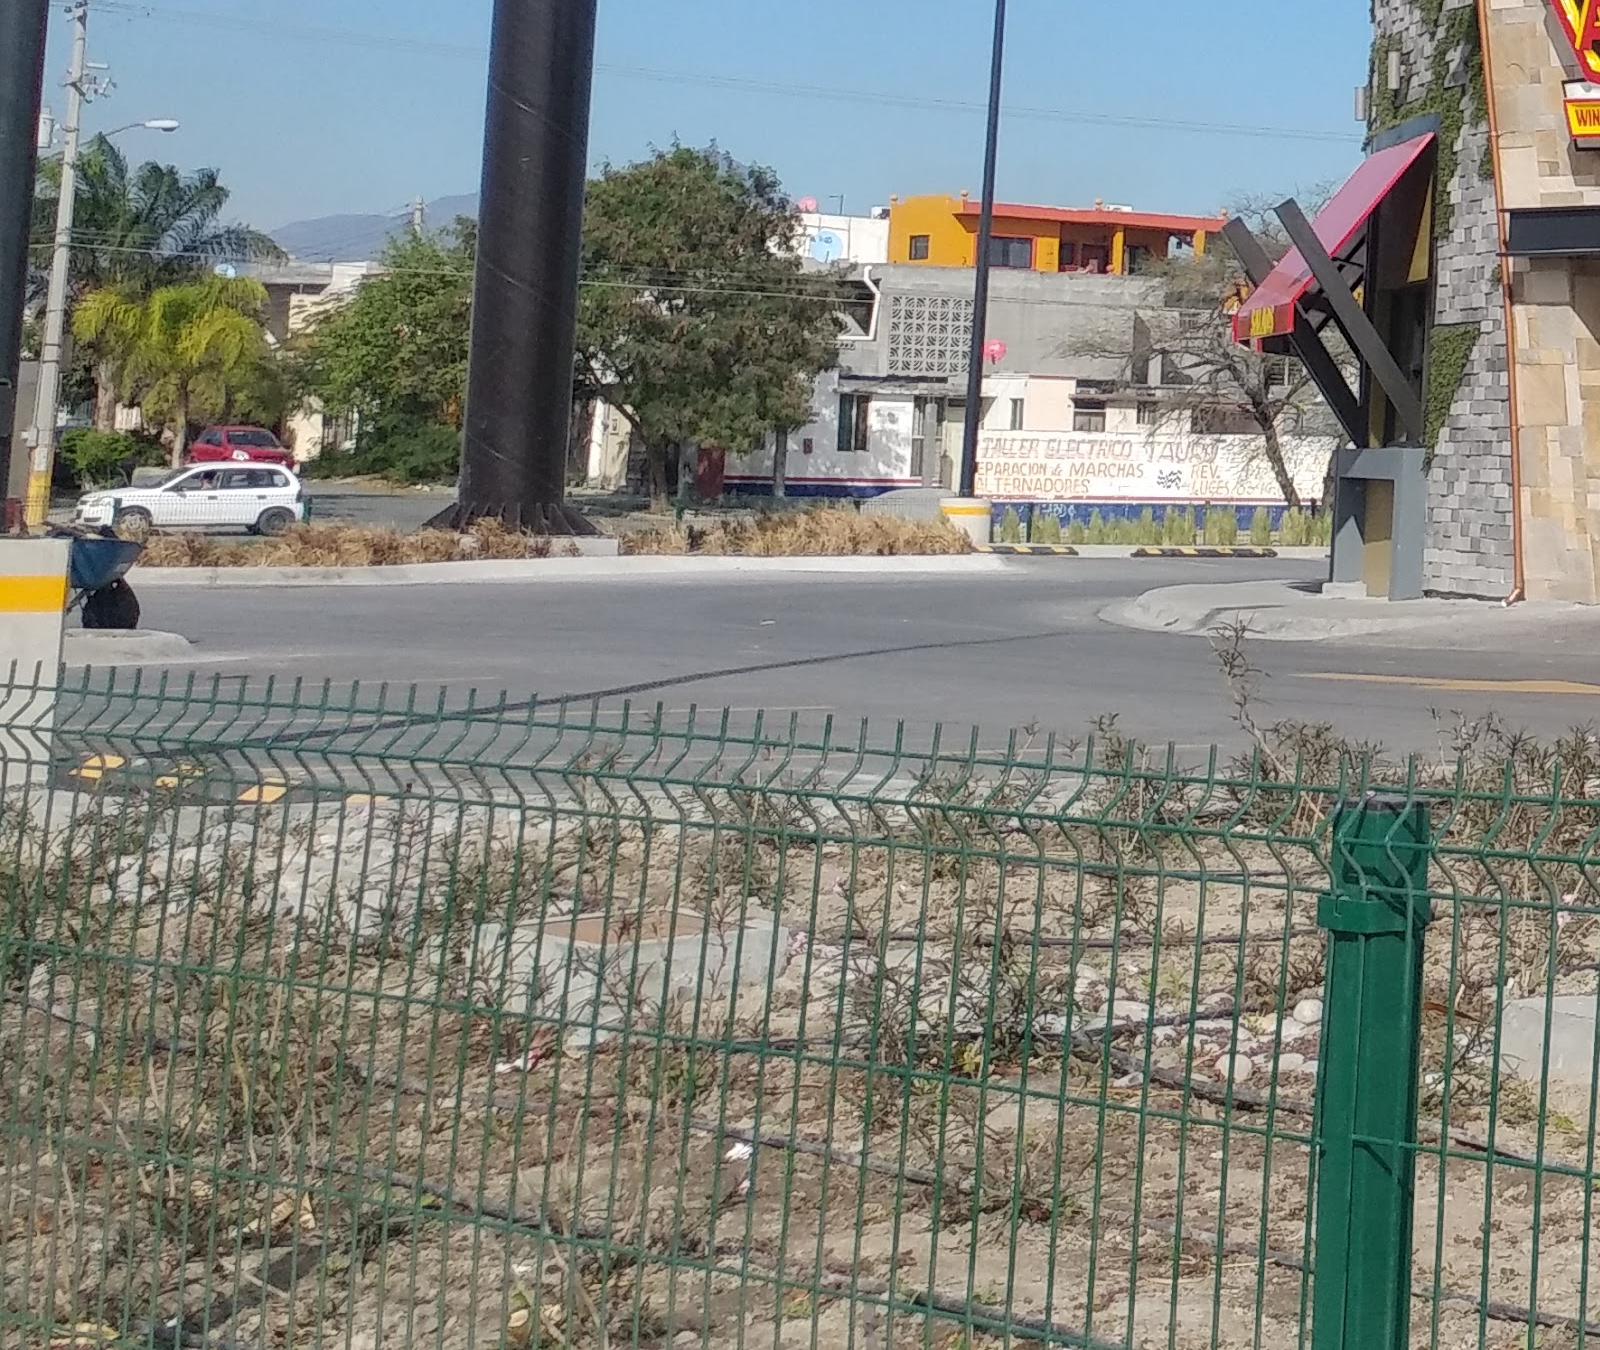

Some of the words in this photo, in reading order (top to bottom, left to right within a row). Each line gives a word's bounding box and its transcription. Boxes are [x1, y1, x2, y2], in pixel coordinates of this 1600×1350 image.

[982, 437, 1039, 459] TALLER
[1045, 438, 1133, 459] ELECTRICO
[976, 462, 1047, 477] EPARACION
[1069, 463, 1144, 478] MARCHAS
[976, 478, 1090, 493] ALTERNADORES
